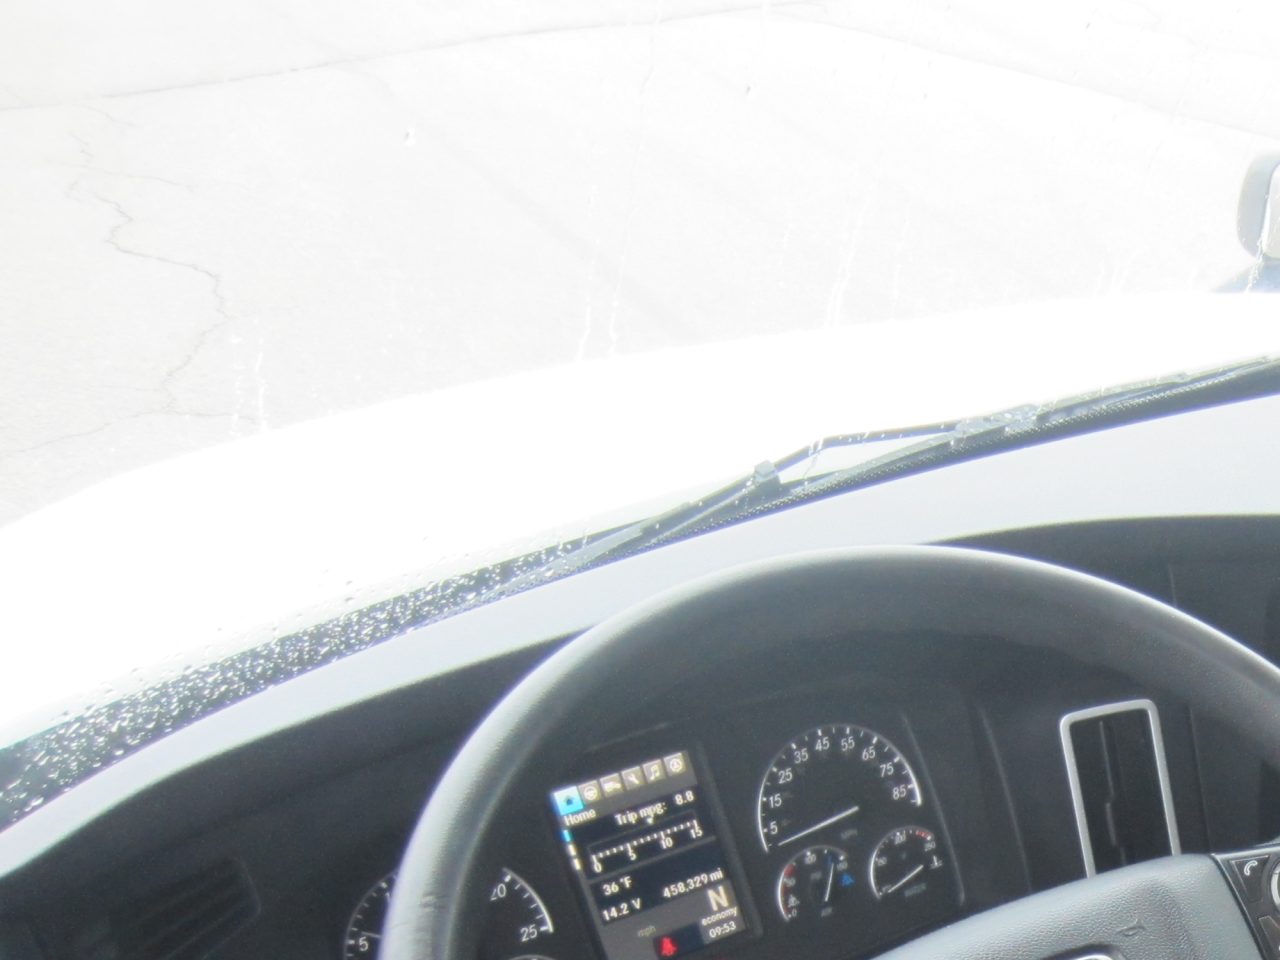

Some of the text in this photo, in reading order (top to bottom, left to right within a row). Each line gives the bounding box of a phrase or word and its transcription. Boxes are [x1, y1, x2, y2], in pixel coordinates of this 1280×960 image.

[815, 737, 830, 751] 45
[841, 736, 855, 751] 55
[794, 749, 809, 764] 35
[862, 747, 876, 761] 65
[778, 768, 793, 784] 25
[880, 763, 894, 777] 75
[893, 786, 906, 800] 85
[615, 790, 695, 826] Trip mpg: 8.8
[769, 794, 782, 808] 15
[564, 809, 597, 826] Home
[690, 828, 703, 839] 15
[770, 822, 778, 835] 5
[660, 836, 674, 850] 10
[628, 851, 637, 861] 5
[593, 861, 603, 873] 0
[603, 881, 620, 896] 36
[663, 867, 724, 898] 458,329 mi
[707, 885, 729, 912] N
[602, 898, 642, 922] 14.2 V
[701, 906, 738, 927] economy
[520, 924, 538, 942] 25
[709, 921, 737, 939] 09:53
[358, 936, 369, 951] 5
